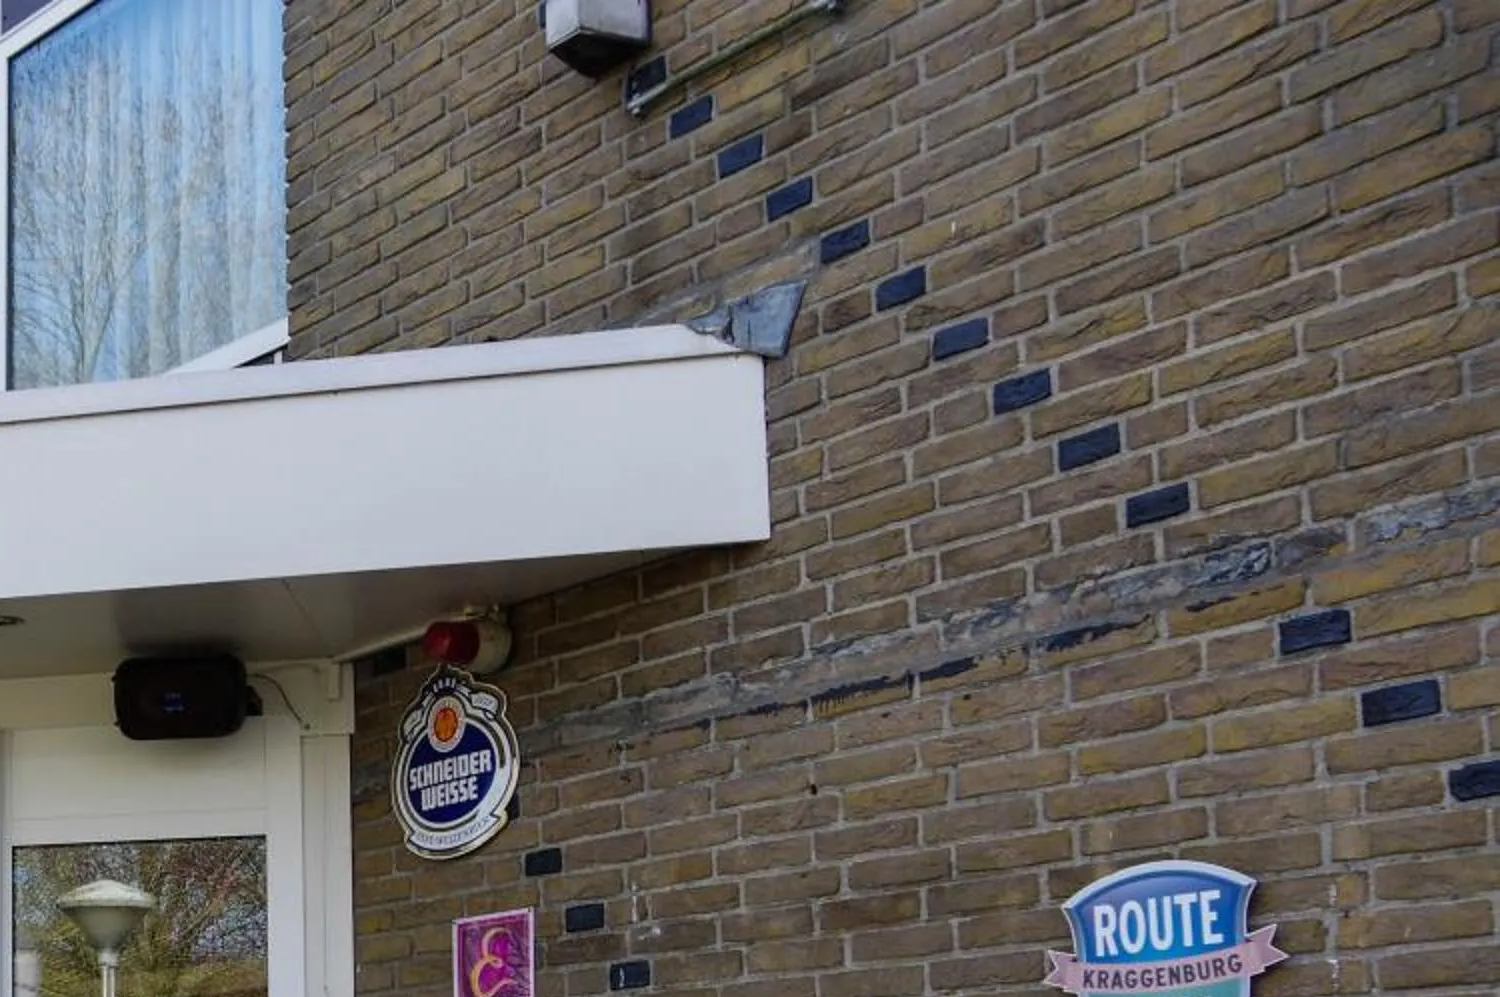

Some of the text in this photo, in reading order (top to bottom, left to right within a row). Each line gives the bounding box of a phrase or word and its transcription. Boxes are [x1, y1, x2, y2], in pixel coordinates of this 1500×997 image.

[410, 750, 492, 791] SCHNEIDER
[420, 776, 479, 811] WEISSE
[1092, 889, 1224, 958] ROUTE
[1081, 953, 1244, 990] KRAGGENBURG
